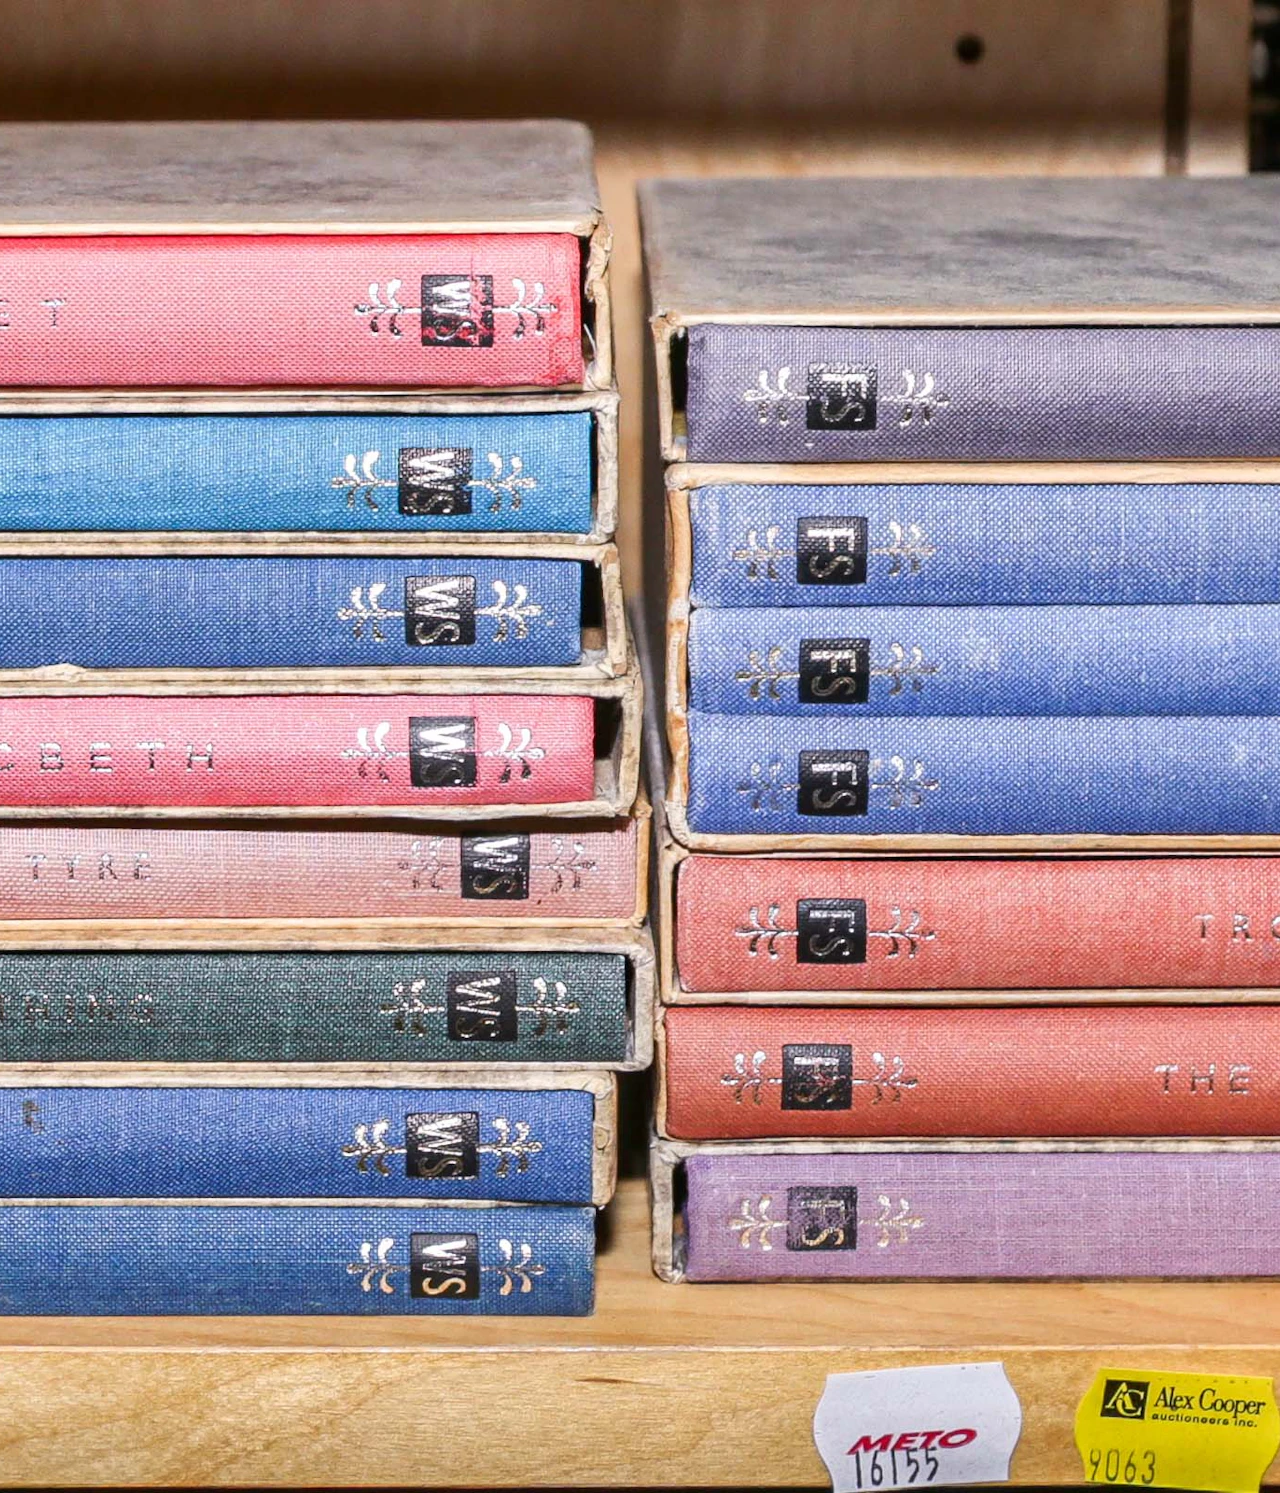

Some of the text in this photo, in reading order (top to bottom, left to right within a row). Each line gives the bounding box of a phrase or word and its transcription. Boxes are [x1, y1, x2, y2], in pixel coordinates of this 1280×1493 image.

[818, 373, 870, 424] FS
[401, 450, 457, 512] WS
[805, 525, 857, 580] FS
[413, 579, 461, 644] WS
[809, 648, 858, 698] FS
[418, 722, 467, 784] WS
[810, 759, 859, 810] FS
[471, 836, 520, 896] WS
[807, 908, 857, 957] FS
[454, 976, 502, 1040] WS
[1154, 1064, 1253, 1095] THE
[417, 1116, 464, 1180] WS
[420, 1239, 470, 1297] WS
[1106, 1382, 1144, 1416] AC
[1152, 1413, 1257, 1428] auctioneers inc.
[1154, 1387, 1266, 1418] Alex Cooper
[847, 1429, 978, 1455] METO
[854, 1447, 939, 1488] 16155
[1090, 1450, 1156, 1484] 9063
